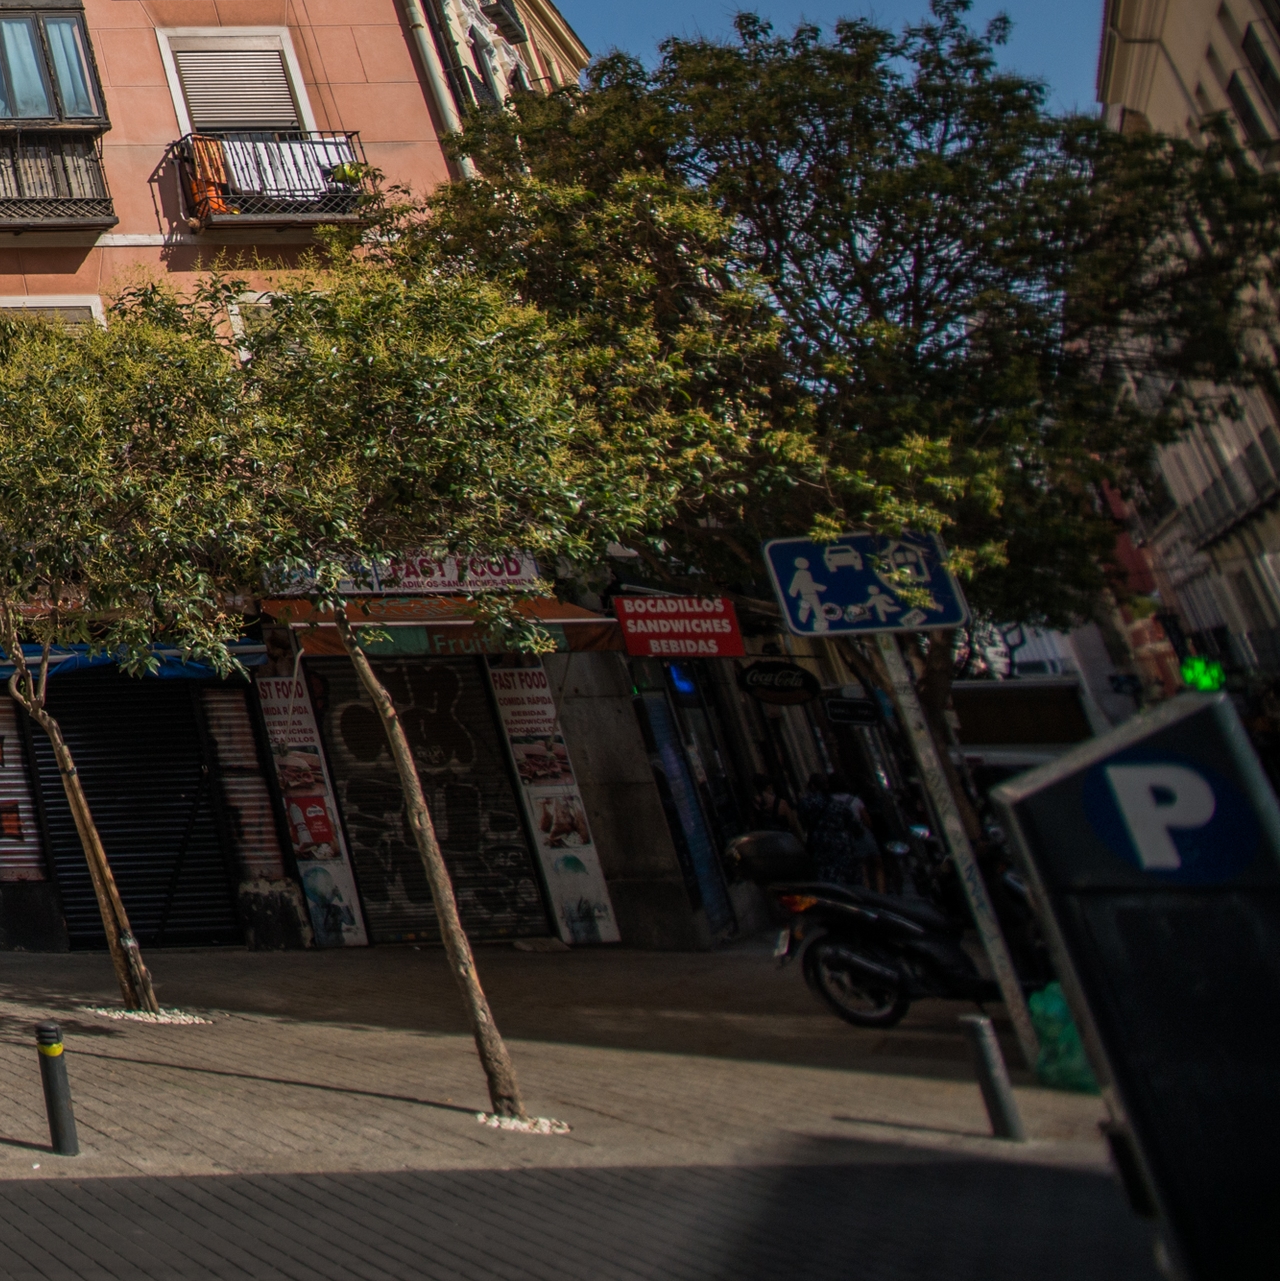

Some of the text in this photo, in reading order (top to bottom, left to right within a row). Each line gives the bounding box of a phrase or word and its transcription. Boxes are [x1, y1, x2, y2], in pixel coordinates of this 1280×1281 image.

[623, 599, 725, 613] BOCADILLOS
[626, 618, 732, 633] SANDWICHES
[649, 639, 719, 654] BEBIDAS
[491, 671, 547, 690] FAST FOOD
[259, 681, 273, 699] ST
[498, 697, 526, 706] COMIDA
[263, 704, 309, 716] MIDA RPIDA
[1105, 763, 1217, 870] P
